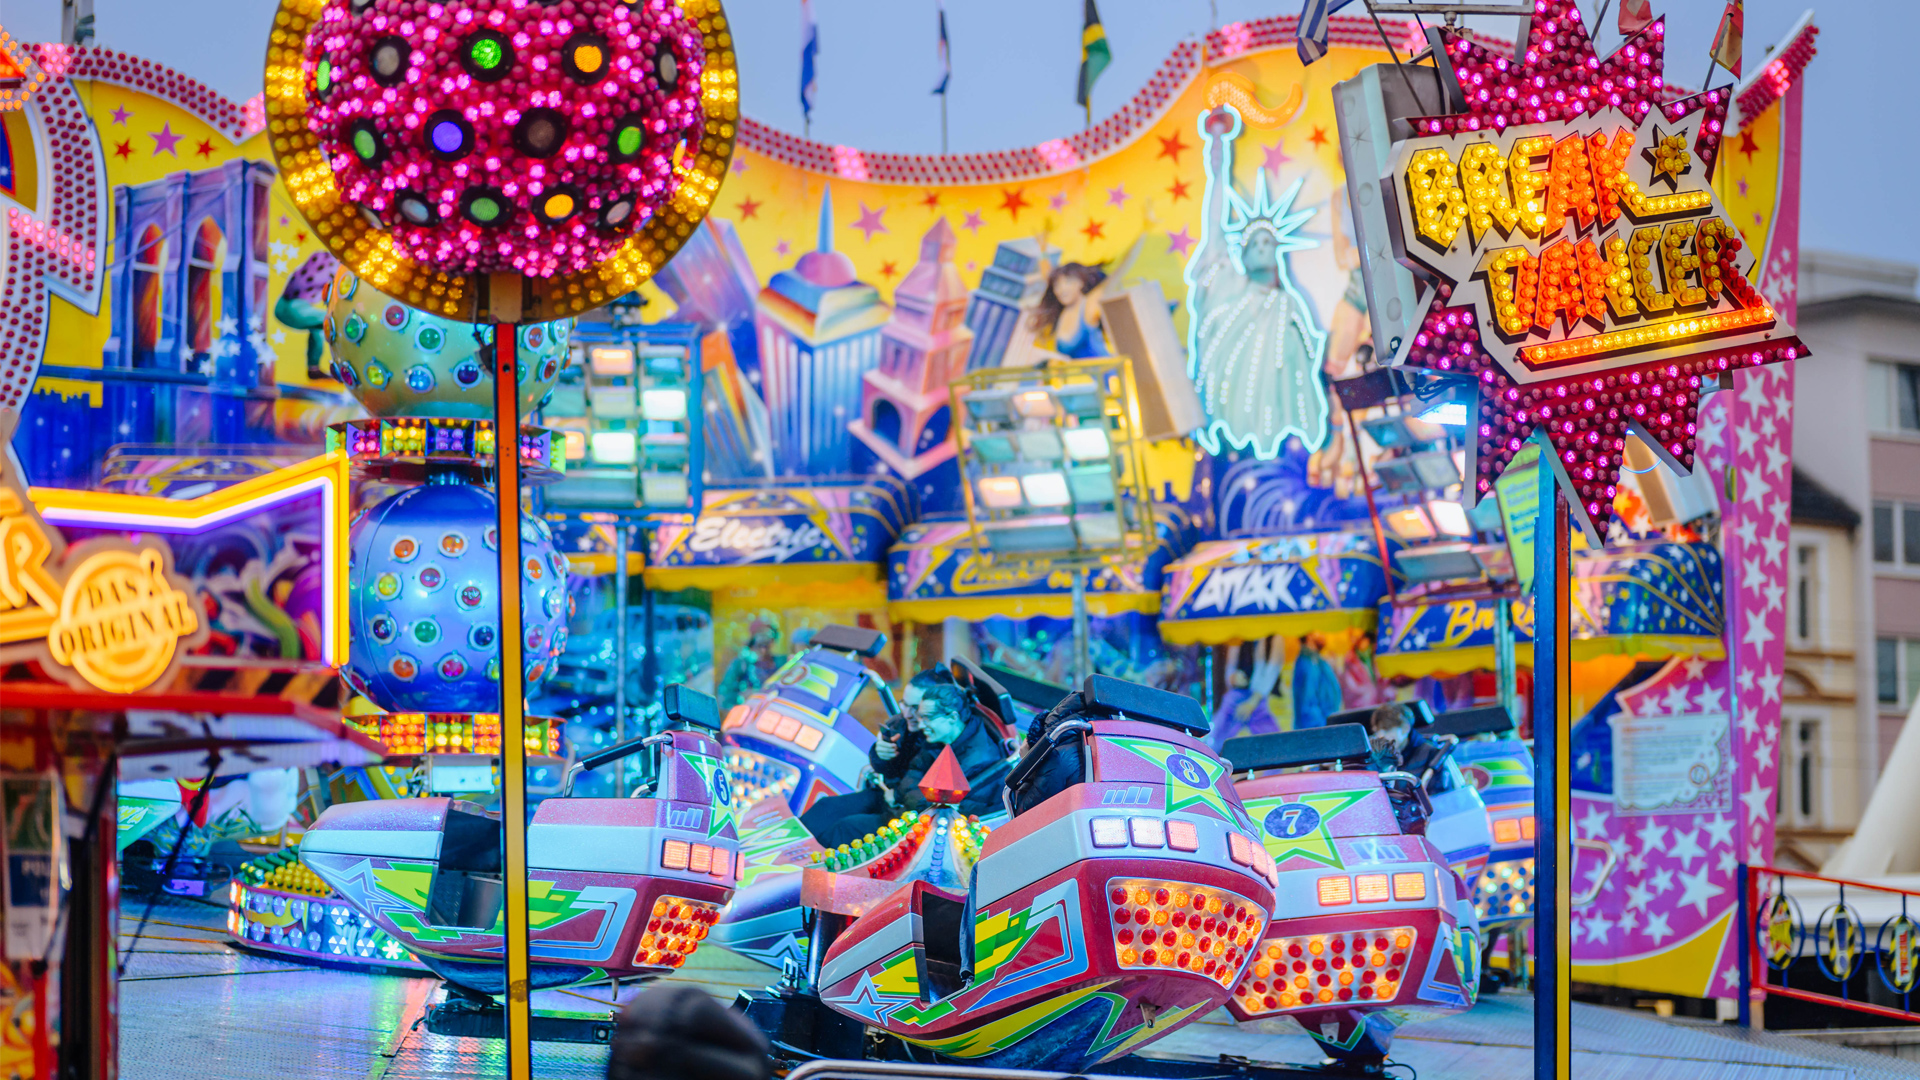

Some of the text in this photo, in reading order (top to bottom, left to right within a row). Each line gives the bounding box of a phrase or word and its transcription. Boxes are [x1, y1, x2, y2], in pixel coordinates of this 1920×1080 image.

[1405, 127, 1712, 254] BREAK
[1471, 216, 1766, 338] DANCER
[688, 515, 823, 553] Electric
[1191, 564, 1300, 614] ATTACK
[51, 593, 196, 663] ORIGINAL
[718, 774, 728, 802] 5
[1178, 758, 1200, 784] 8
[1281, 808, 1303, 836] 7
